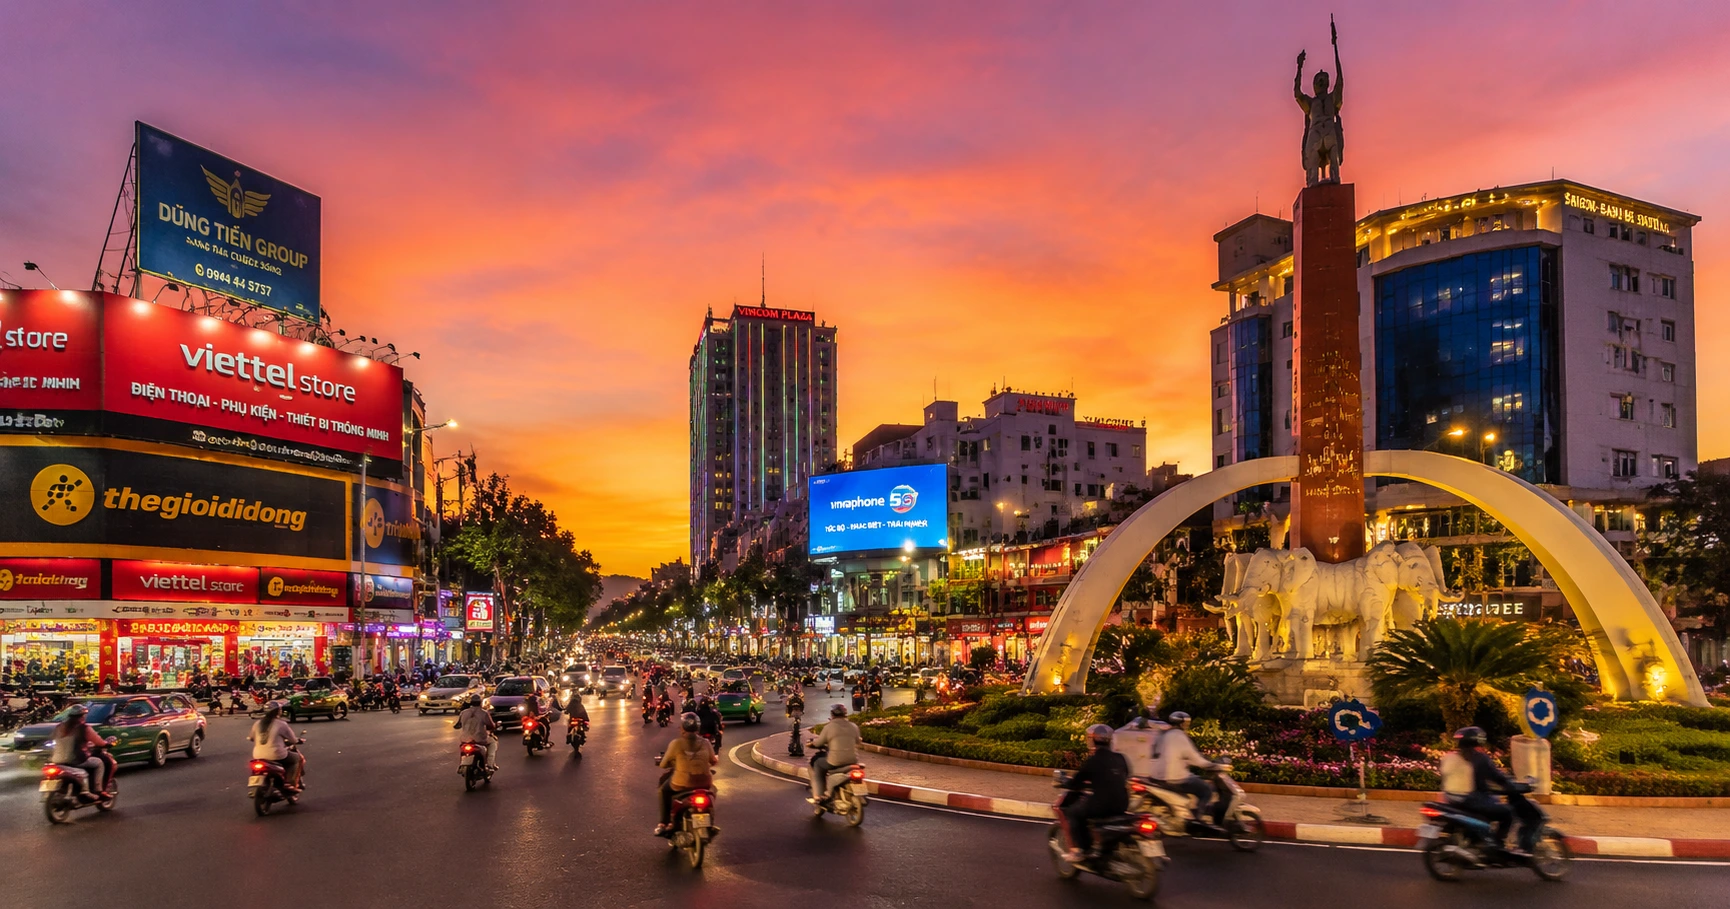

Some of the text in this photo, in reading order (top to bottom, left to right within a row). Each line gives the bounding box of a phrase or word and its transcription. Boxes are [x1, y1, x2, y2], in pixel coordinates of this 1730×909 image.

[255, 238, 309, 269] GROUP
[247, 280, 273, 297] 5757
[737, 306, 779, 319] VINCOM
[5, 326, 68, 349] store
[179, 343, 356, 402] viettel store
[131, 381, 166, 401] ĐIỆN
[221, 398, 247, 417] PHỤ
[250, 404, 277, 422] KIỆN
[103, 486, 308, 532] thegioididong
[140, 573, 207, 591] viettel
